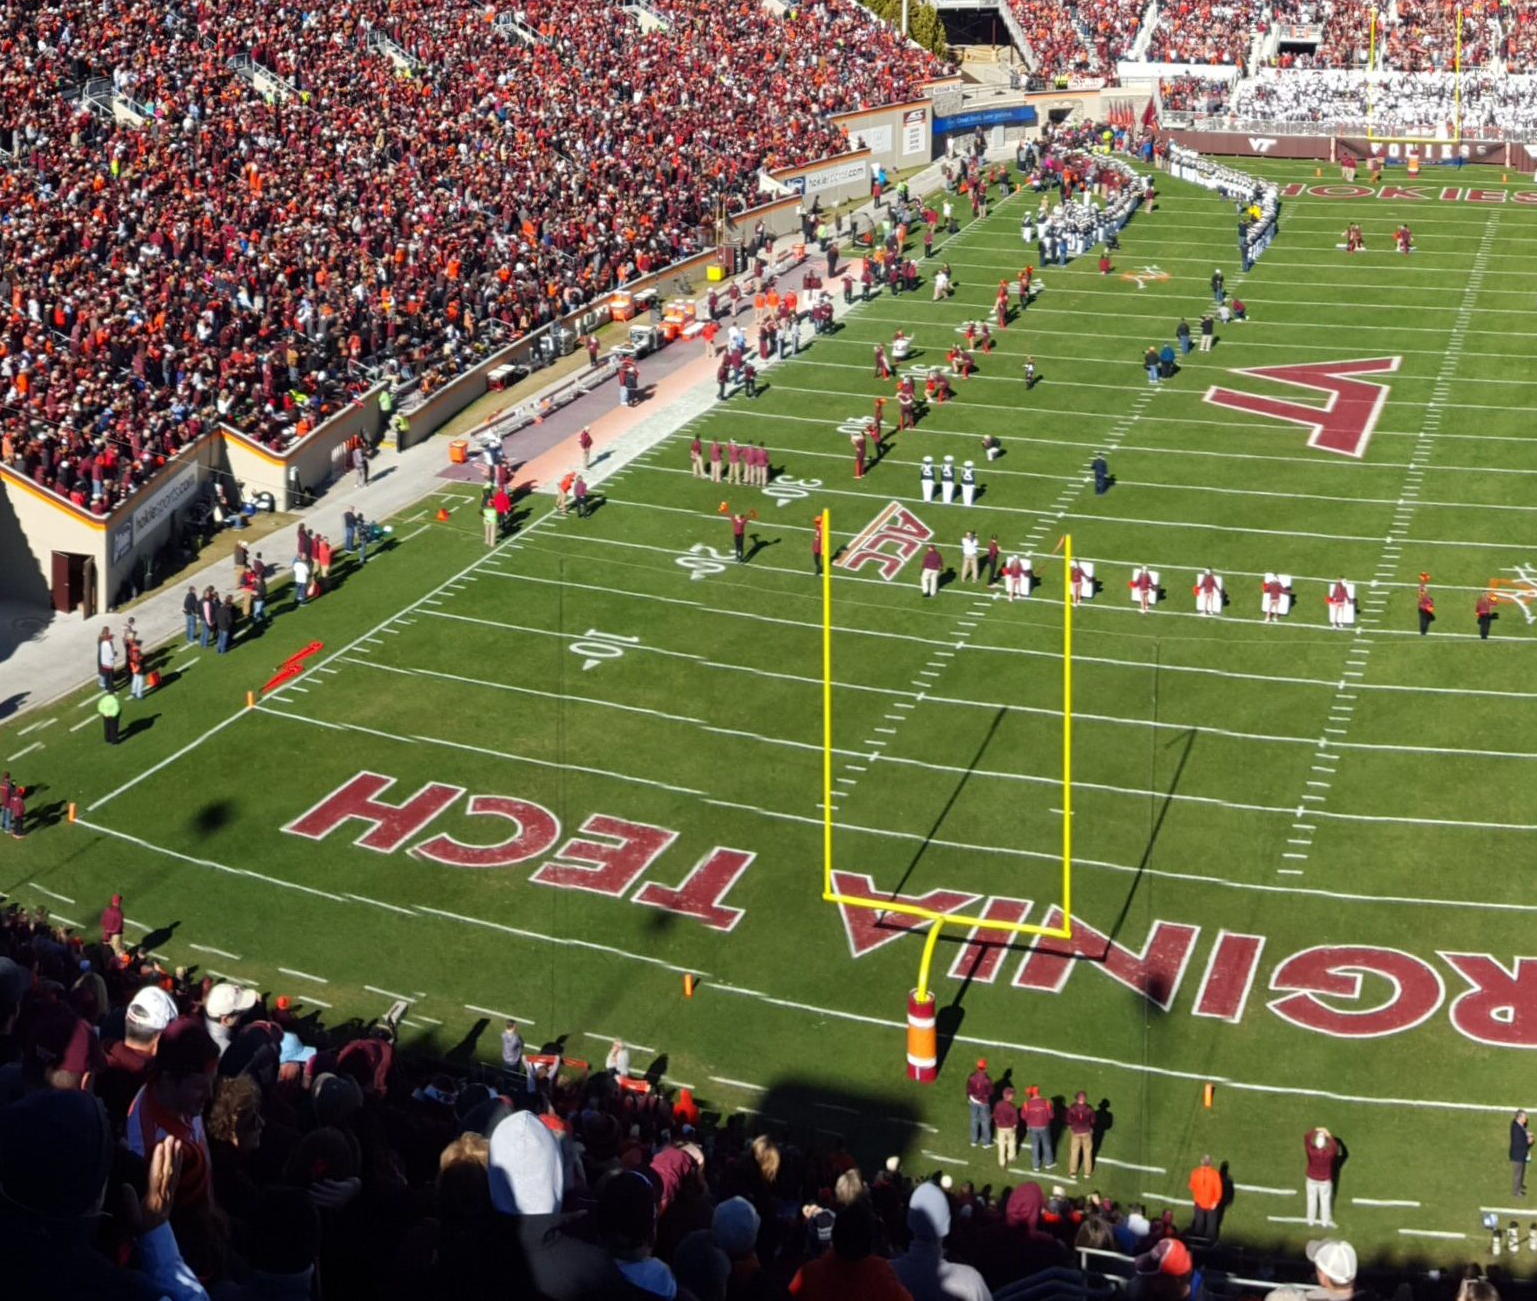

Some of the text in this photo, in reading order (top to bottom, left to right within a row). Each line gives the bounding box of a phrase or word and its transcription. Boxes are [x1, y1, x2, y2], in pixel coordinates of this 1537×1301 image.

[1248, 137, 1277, 152] VT
[761, 474, 823, 499] 30
[842, 502, 936, 581] ACC
[674, 542, 738, 574] 20
[568, 627, 640, 659] 10
[279, 769, 758, 932] TECH
